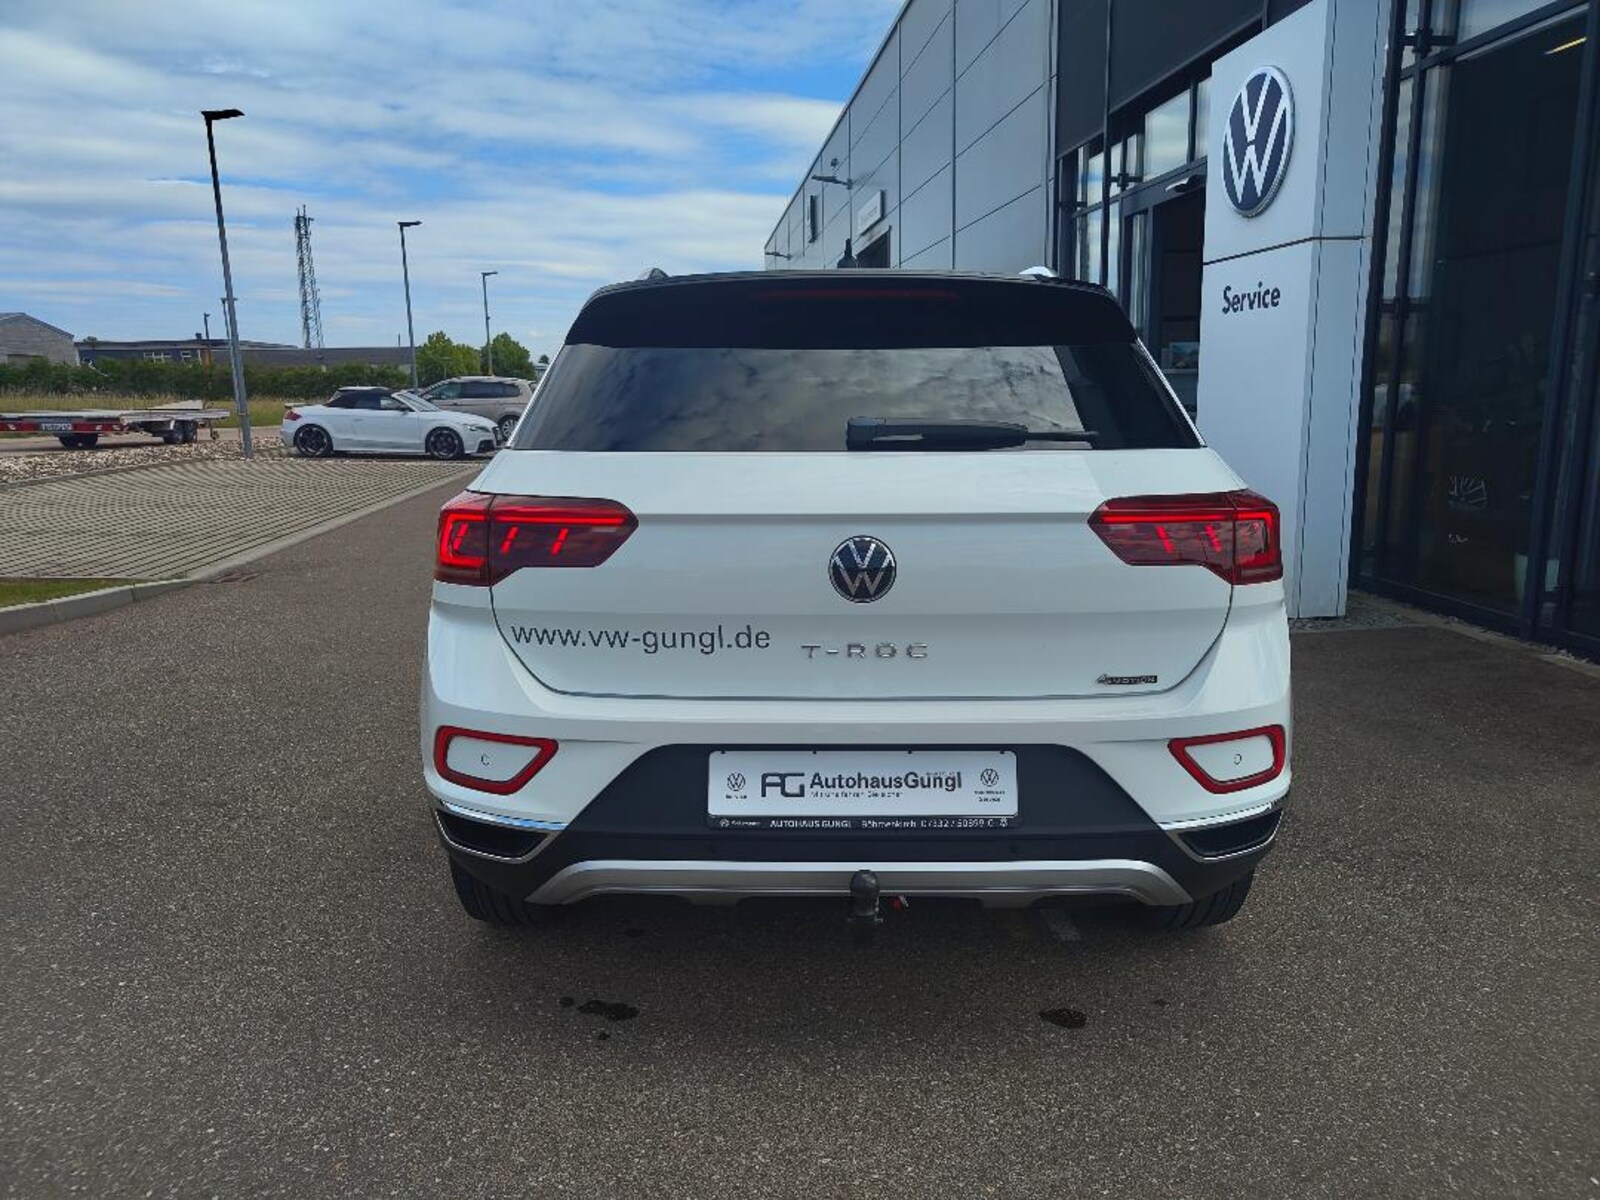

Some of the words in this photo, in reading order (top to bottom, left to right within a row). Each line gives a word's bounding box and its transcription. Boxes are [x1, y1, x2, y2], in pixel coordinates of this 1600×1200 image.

[1222, 65, 1294, 217] VW
[1222, 281, 1281, 314] Service
[830, 536, 897, 602] VW
[511, 624, 771, 655] www.vw-gungl.de
[801, 642, 928, 659] T-ROC
[761, 772, 805, 798] AG
